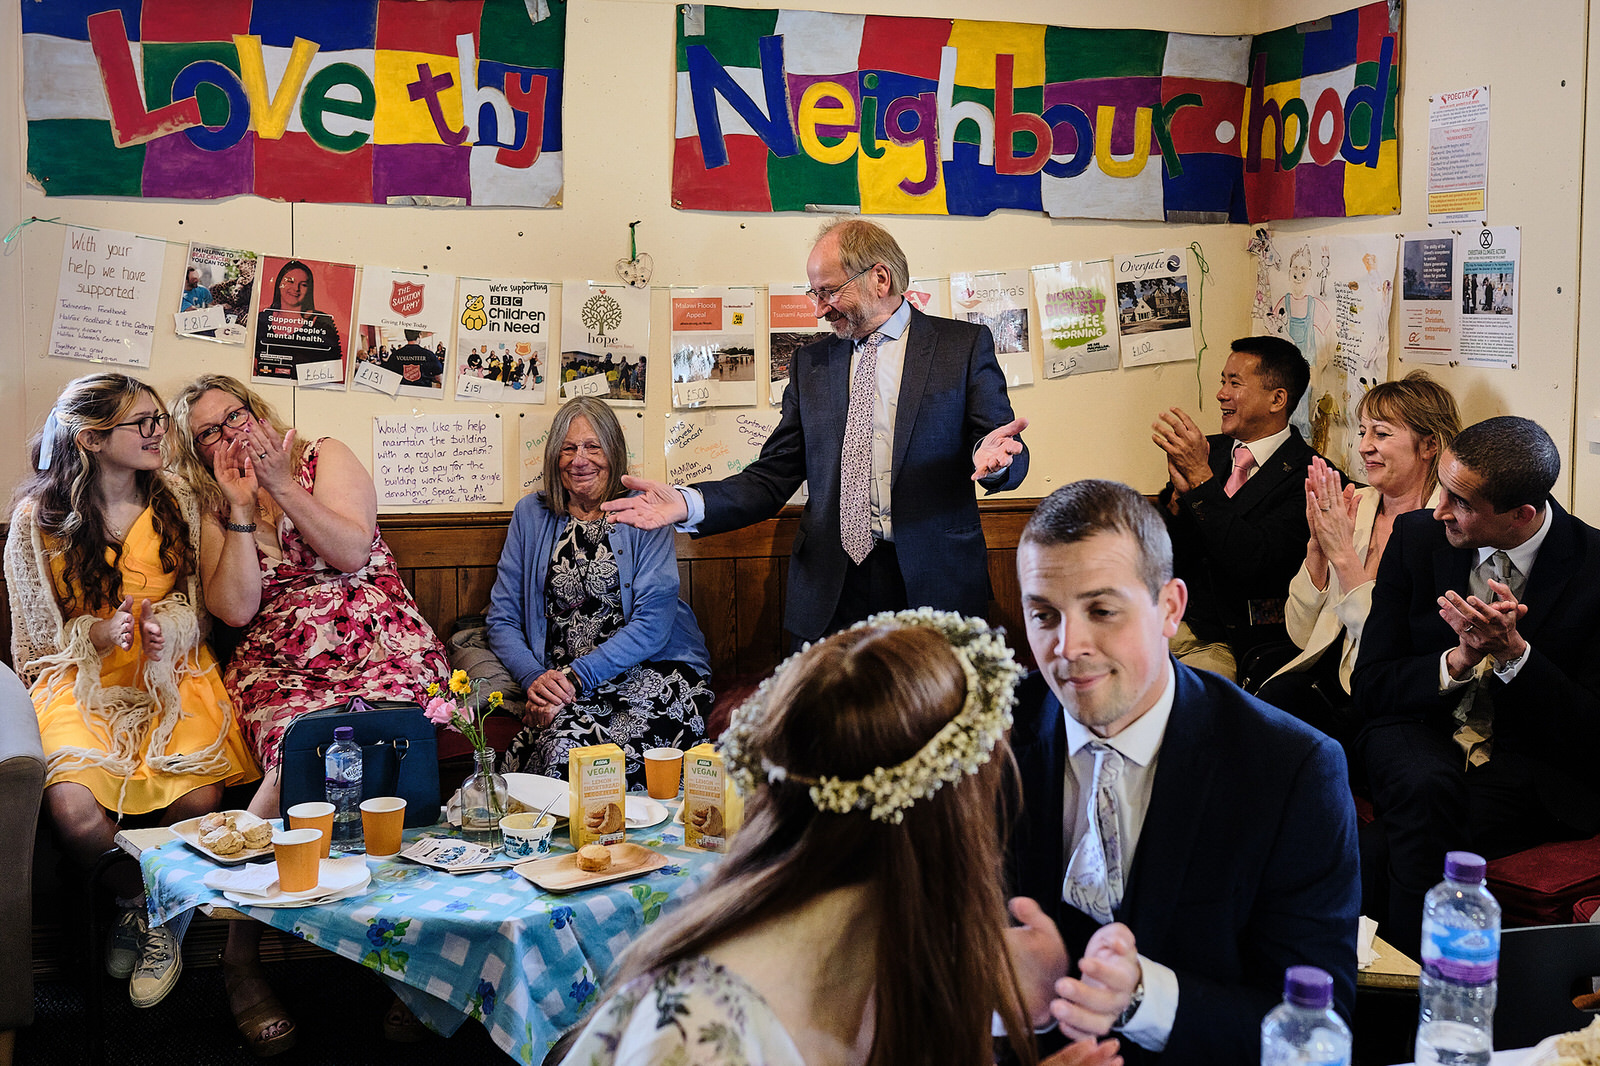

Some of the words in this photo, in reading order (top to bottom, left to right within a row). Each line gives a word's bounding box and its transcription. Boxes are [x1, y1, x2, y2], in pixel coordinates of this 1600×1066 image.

[88, 8, 376, 153] Love
[406, 33, 548, 168] thy
[72, 232, 96, 252] With
[106, 244, 132, 260] your
[202, 249, 225, 257] HELPING
[69, 257, 95, 279] help
[103, 267, 115, 278] we
[123, 267, 146, 282] have
[1120, 259, 1165, 279] Overgate
[398, 286, 411, 296] THE
[489, 284, 508, 292] We're
[510, 283, 548, 294] supporting
[977, 286, 1024, 299] samara's
[392, 290, 421, 306] SALVATION
[491, 296, 522, 306] BBC
[1046, 290, 1092, 302] WORLD'S
[402, 299, 420, 312] ARMY
[1045, 299, 1106, 317] BIGGEST
[489, 308, 546, 321] Children
[184, 315, 211, 331] £812
[268, 316, 314, 327] Supporting
[489, 321, 500, 332] in
[504, 322, 540, 334] Need
[1051, 314, 1100, 331] COFFEE
[267, 325, 292, 333] young
[296, 334, 324, 343] health.
[588, 333, 619, 348] hope
[360, 369, 383, 384] £131
[464, 382, 482, 394] £151
[688, 387, 710, 400] £500
[375, 417, 407, 434] Would
[411, 426, 428, 439] you
[433, 422, 450, 432] like
[453, 421, 463, 432] to
[468, 420, 486, 434] help
[668, 424, 695, 445] Harvest
[430, 436, 445, 446] the
[451, 434, 487, 448] building
[679, 427, 704, 449] Concert
[748, 437, 763, 447] Con
[378, 451, 396, 459] with
[416, 449, 447, 464] regular
[453, 445, 493, 456] donation?
[398, 465, 415, 475] help
[433, 466, 447, 476] pay
[450, 461, 464, 473] for
[467, 461, 484, 470] the
[728, 459, 741, 470] Big
[686, 464, 713, 480] Morning
[385, 477, 417, 489] building
[422, 475, 443, 484] work
[447, 474, 465, 483] with
[480, 473, 500, 486] single
[432, 487, 456, 498] Speak
[459, 485, 468, 493] to
[587, 767, 616, 777] VEGAN
[692, 768, 718, 778] VEGAN
